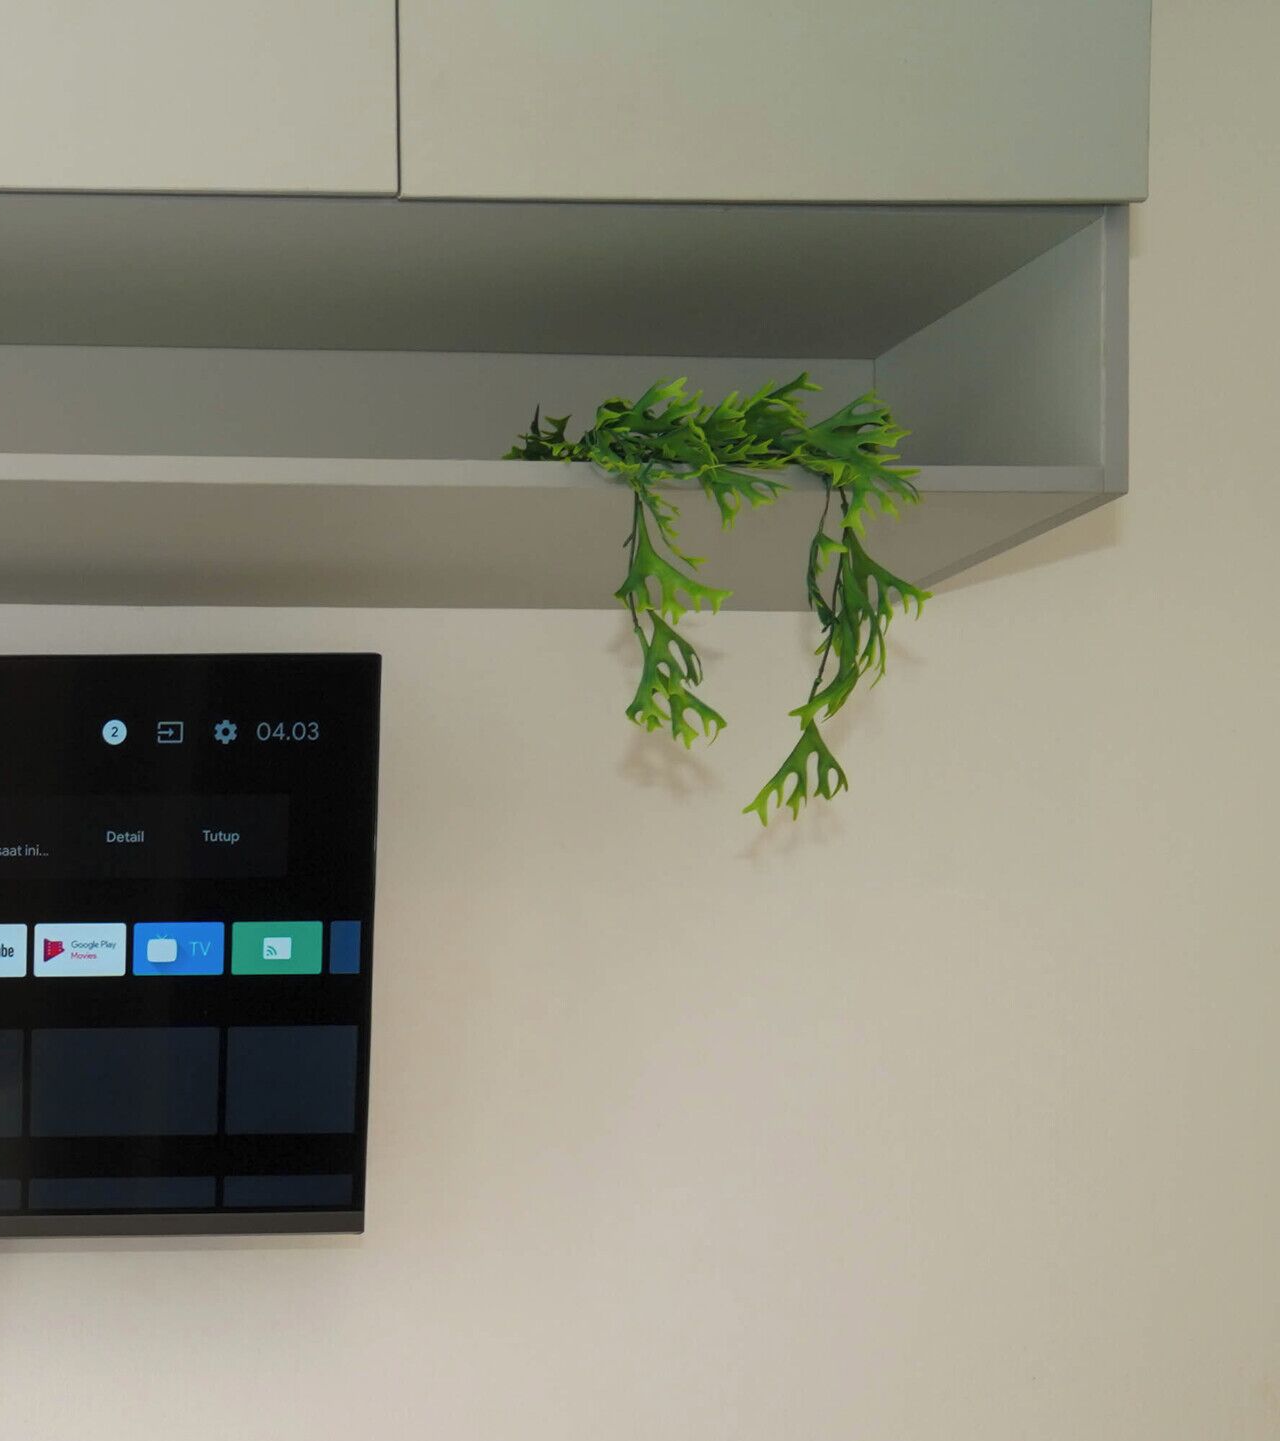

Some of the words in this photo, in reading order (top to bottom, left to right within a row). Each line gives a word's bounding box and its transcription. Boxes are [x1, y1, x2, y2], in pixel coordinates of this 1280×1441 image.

[110, 726, 119, 738] 2
[256, 721, 320, 741] 04.03
[106, 830, 145, 843] Detail
[203, 829, 240, 844] Tutup
[71, 940, 100, 950] Google
[100, 940, 116, 950] Play
[189, 941, 211, 957] TV
[71, 952, 97, 960] Movies
